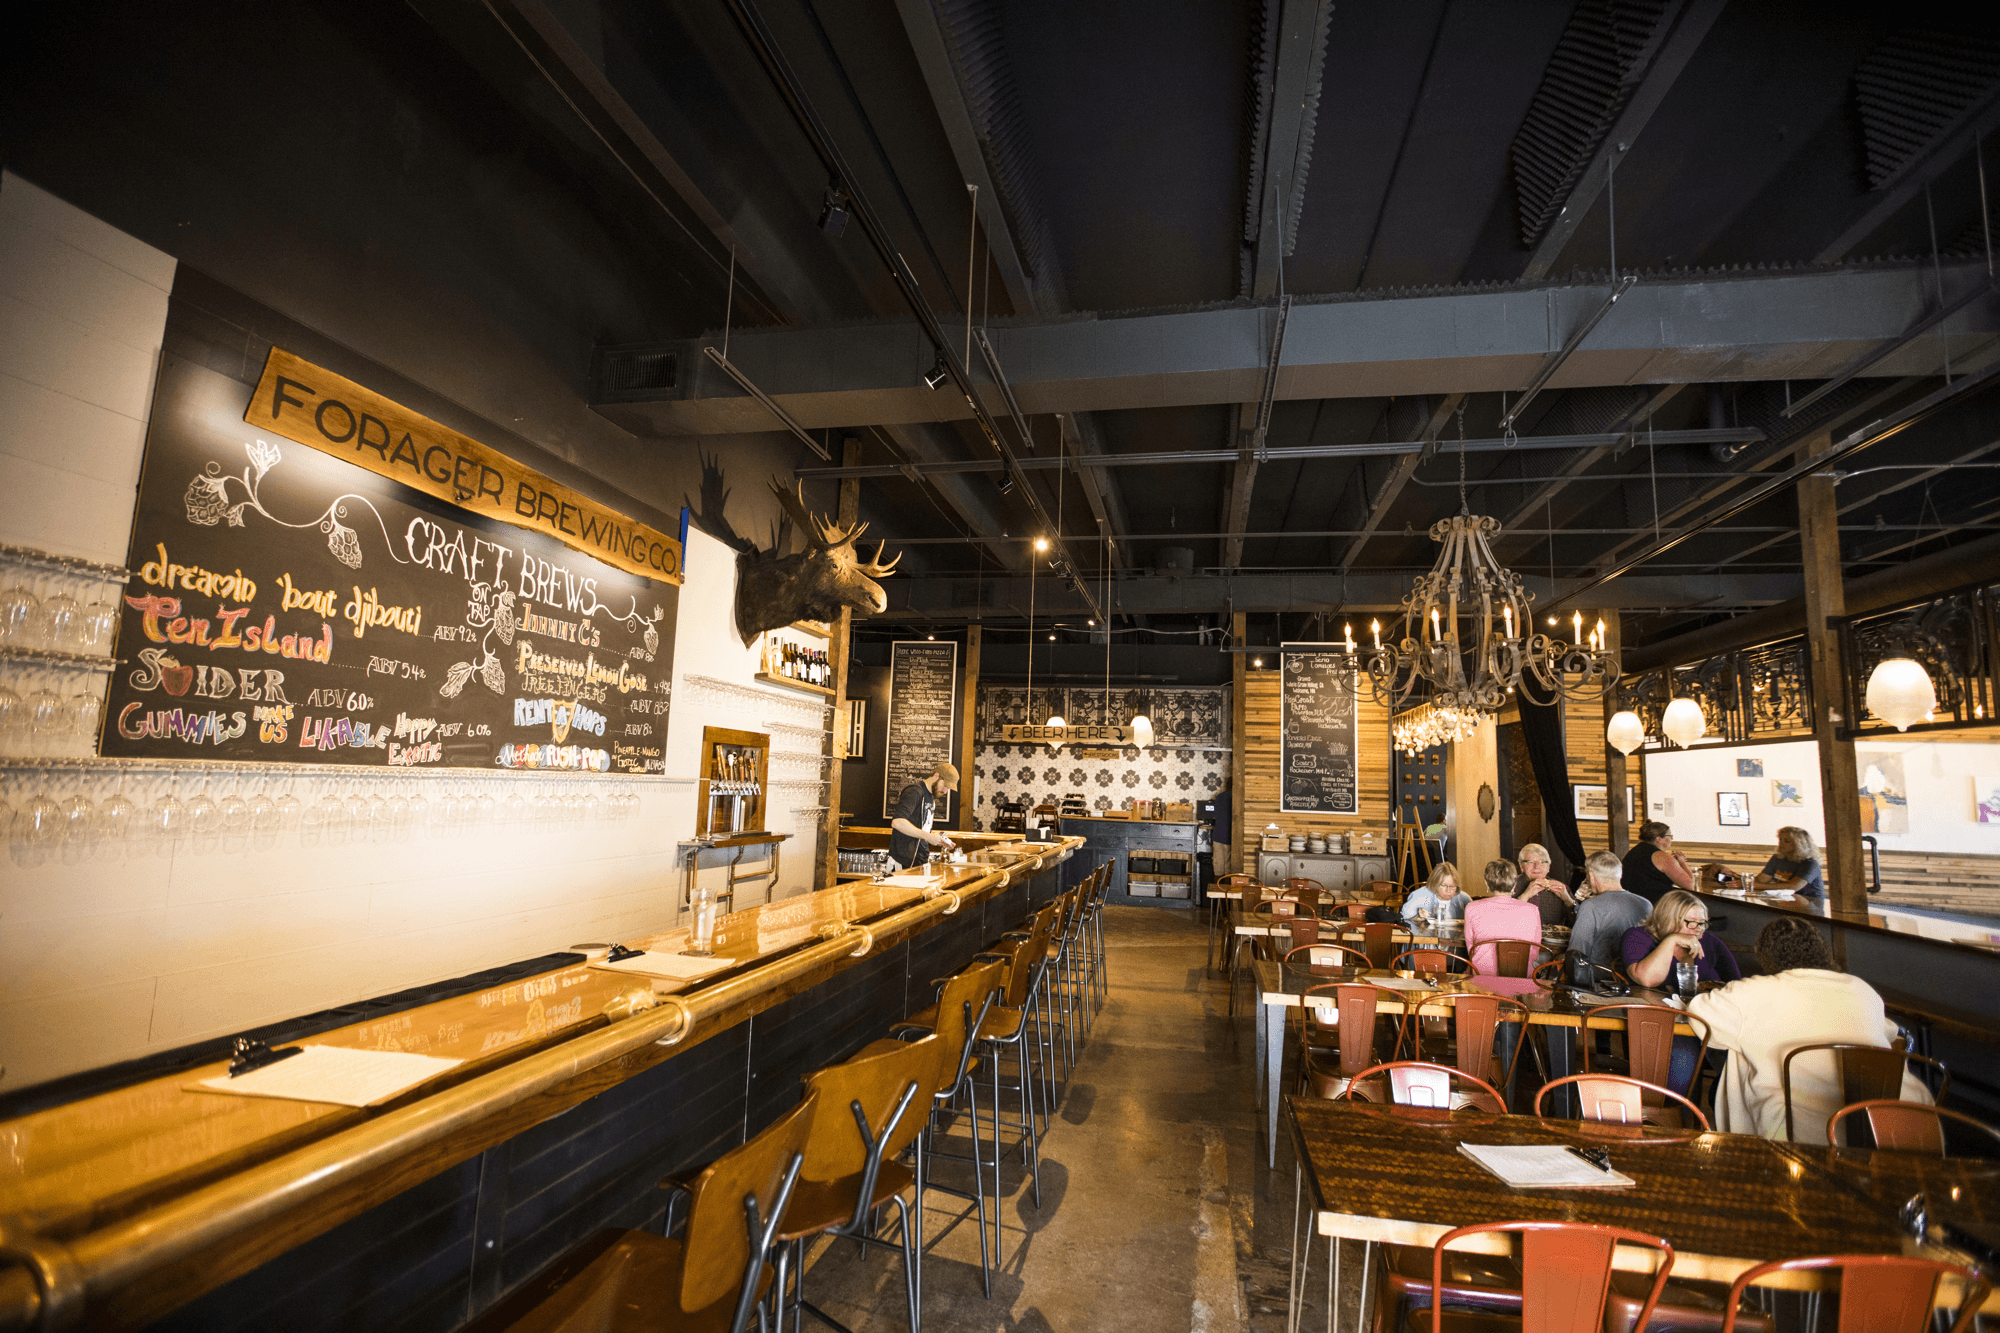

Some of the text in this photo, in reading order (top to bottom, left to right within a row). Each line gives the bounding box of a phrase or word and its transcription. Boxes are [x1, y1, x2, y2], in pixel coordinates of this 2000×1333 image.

[271, 374, 678, 578] FORAGER BREWING CO.
[404, 516, 599, 616] CRAFT BREWS
[141, 542, 257, 602] dreamin
[344, 585, 422, 638] djibouti
[472, 587, 490, 602] ON
[468, 600, 490, 621] TAP
[434, 626, 457, 642] ABV
[629, 646, 646, 660] ABV
[366, 655, 400, 677] ABV
[308, 688, 348, 708] ABV
[630, 699, 652, 713] ABV
[118, 702, 247, 745] GUMMIES
[253, 705, 294, 723] MAKE
[259, 722, 287, 743] US
[299, 716, 391, 750] LIKABLE
[436, 723, 463, 741] ABV
[625, 723, 643, 736] ABV
[1022, 726, 1109, 739] BEER HERE
